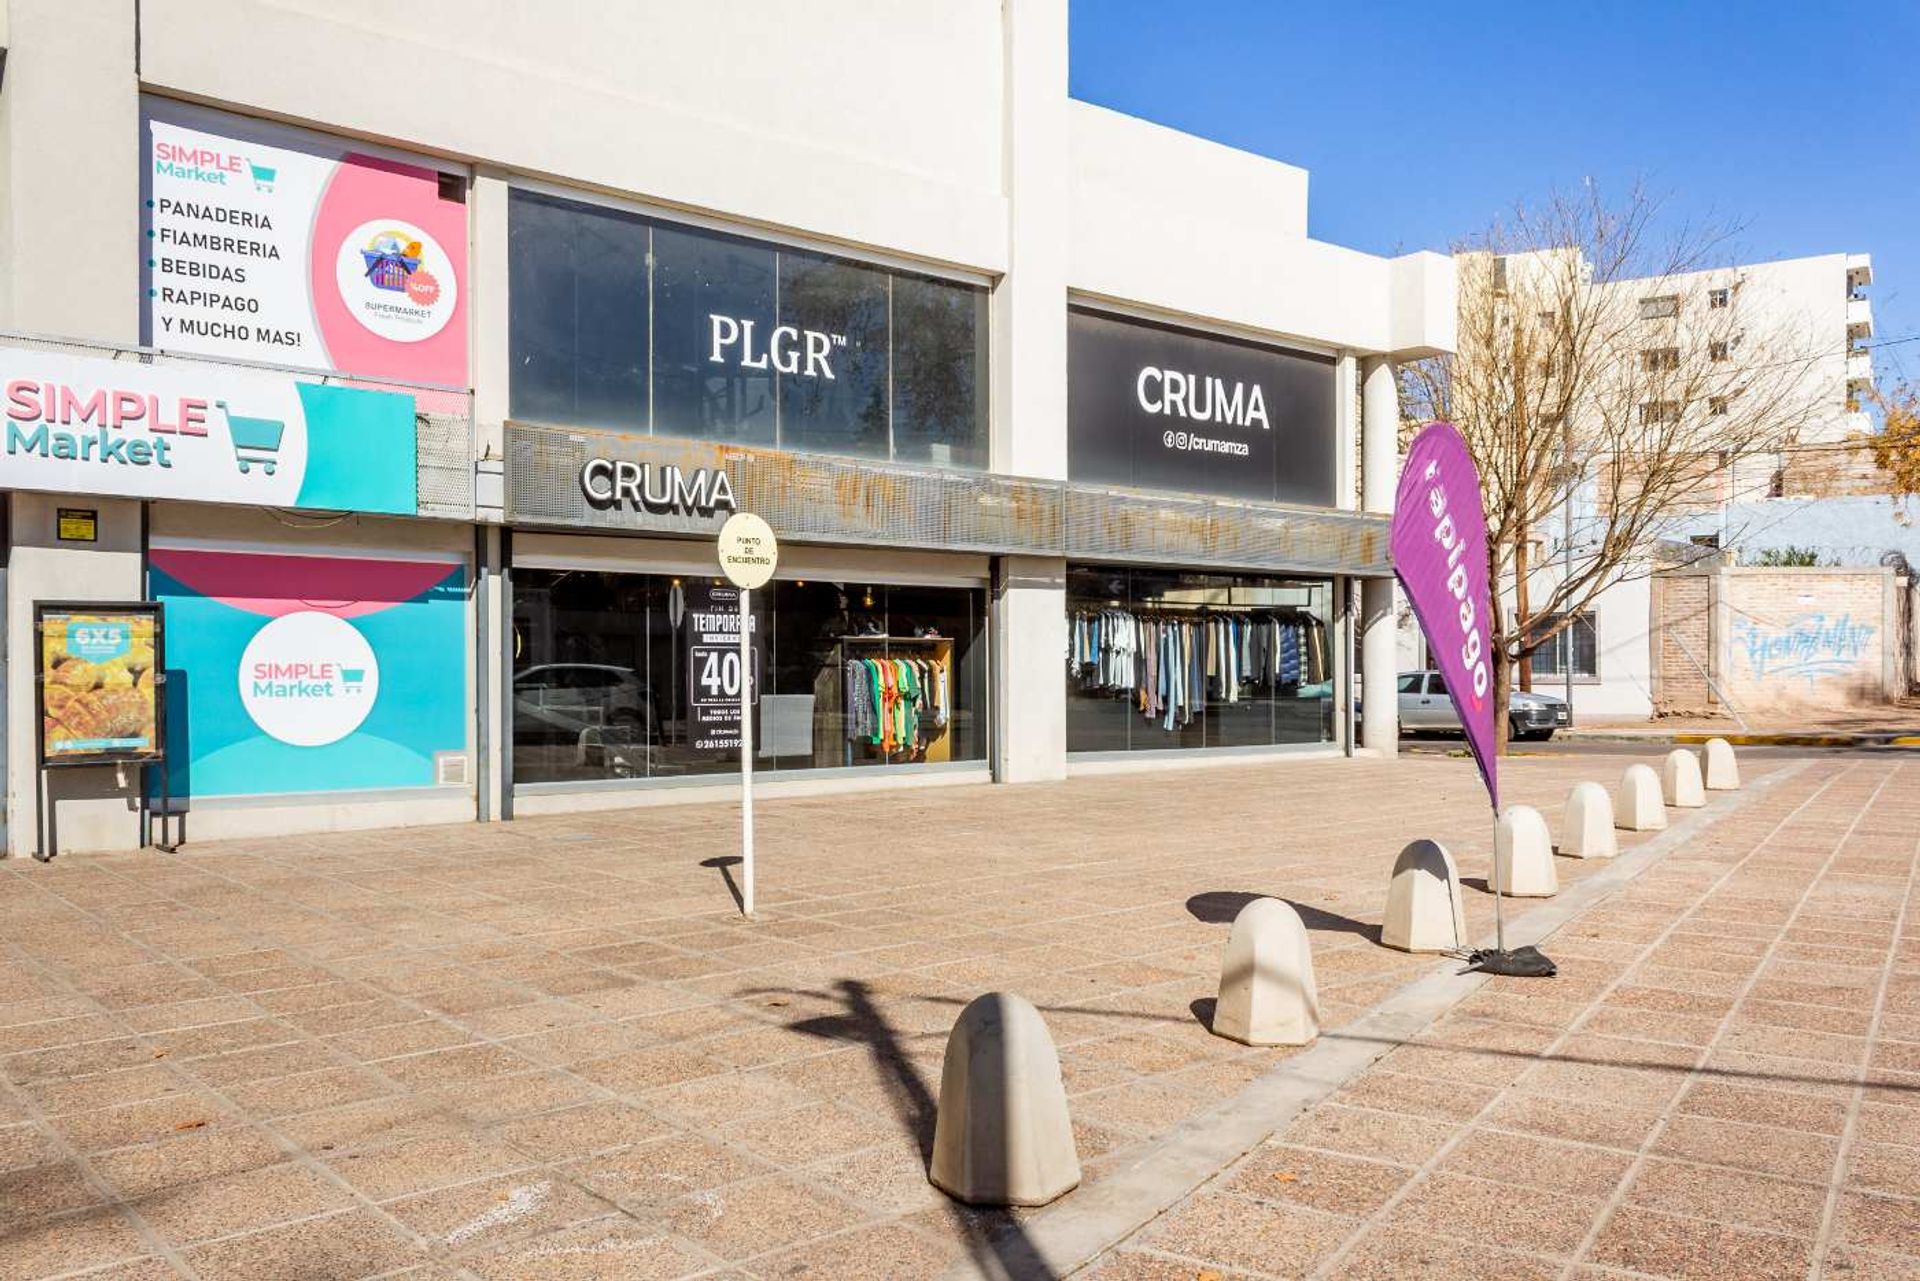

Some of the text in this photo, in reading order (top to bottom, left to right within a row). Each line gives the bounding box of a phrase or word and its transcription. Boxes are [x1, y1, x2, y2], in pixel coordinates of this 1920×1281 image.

[156, 142, 242, 173] SIMPLE
[156, 160, 227, 186] Market
[160, 198, 272, 231] PANADERIA
[160, 227, 280, 260] FIAMBRERIA
[161, 257, 246, 283] BEBIDAS
[162, 287, 259, 313] RAPIPAGO
[365, 301, 432, 319] SUPERMARKET
[161, 316, 301, 347] Y MUCHO MAS!
[6, 379, 209, 438] SIMPLE
[1137, 366, 1270, 430] CRUMA
[6, 420, 173, 468] Market
[580, 457, 738, 516] CRUMA
[736, 535, 761, 546] PUNTO
[744, 546, 755, 555] DE
[726, 555, 771, 566] ENCUENTRO
[692, 613, 756, 633] TEMPORAA
[75, 628, 122, 645] 6X5
[254, 663, 334, 680] SIMPLE
[701, 651, 754, 696] 40
[253, 681, 334, 697] Market
[703, 739, 746, 749] 26155192
